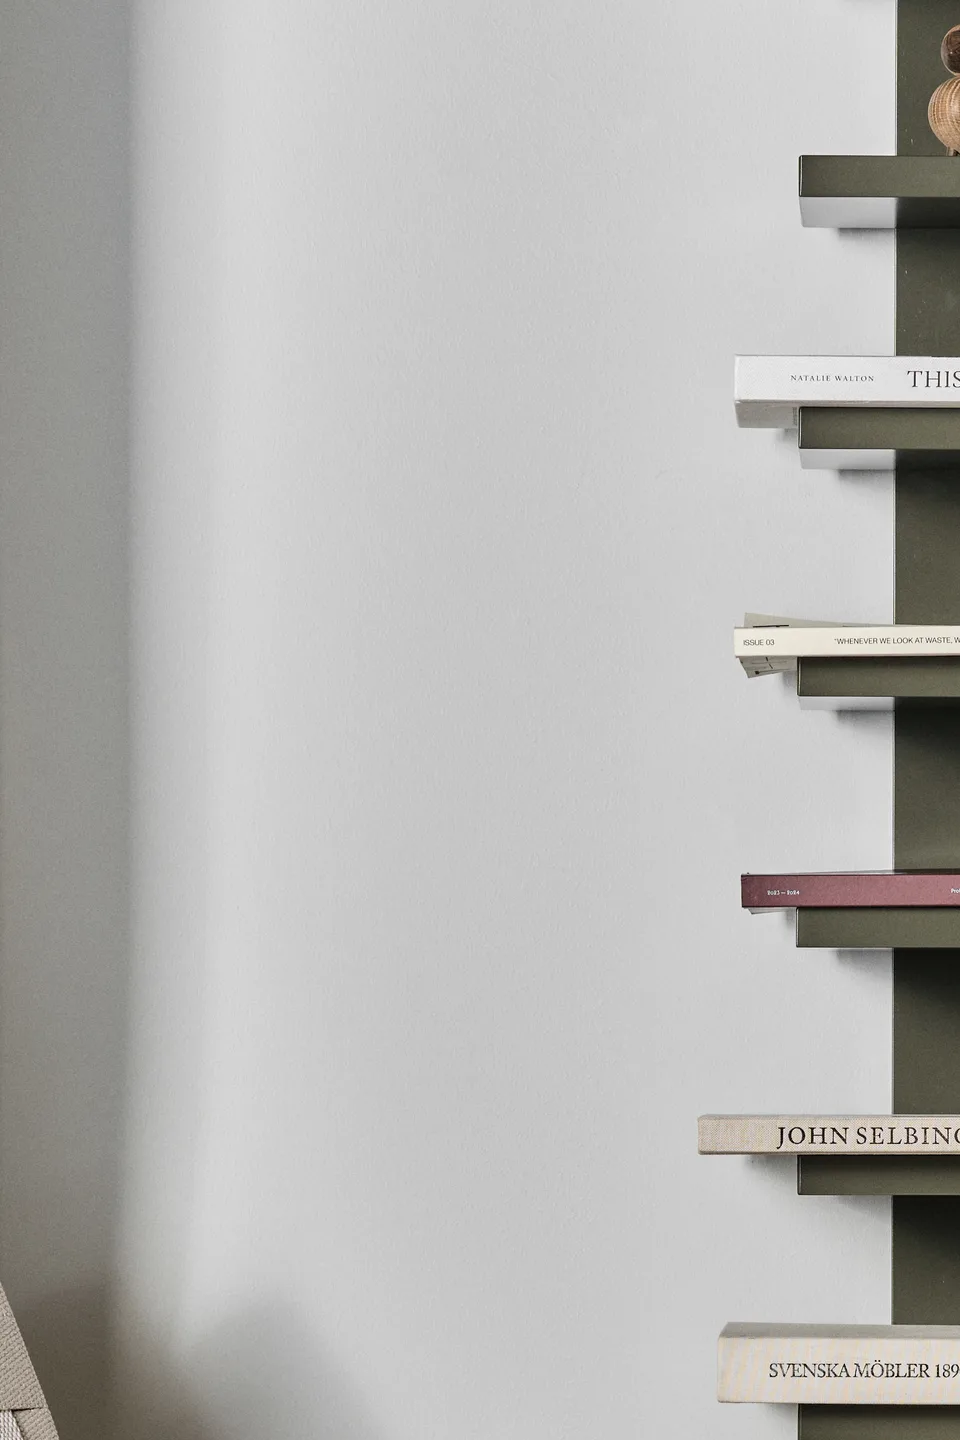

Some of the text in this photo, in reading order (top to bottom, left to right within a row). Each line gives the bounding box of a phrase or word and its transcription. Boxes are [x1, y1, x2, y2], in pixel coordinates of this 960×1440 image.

[790, 374, 874, 383] NATALIE WALTON
[742, 638, 776, 647] ISSUE 03
[879, 637, 891, 645] WE
[892, 636, 914, 645] LOOK
[914, 636, 924, 644] AT
[924, 636, 953, 645] WASTE,
[775, 1126, 850, 1150] JOHN
[768, 1362, 852, 1379] SVENSKA
[854, 1359, 931, 1378] MÖBLER
